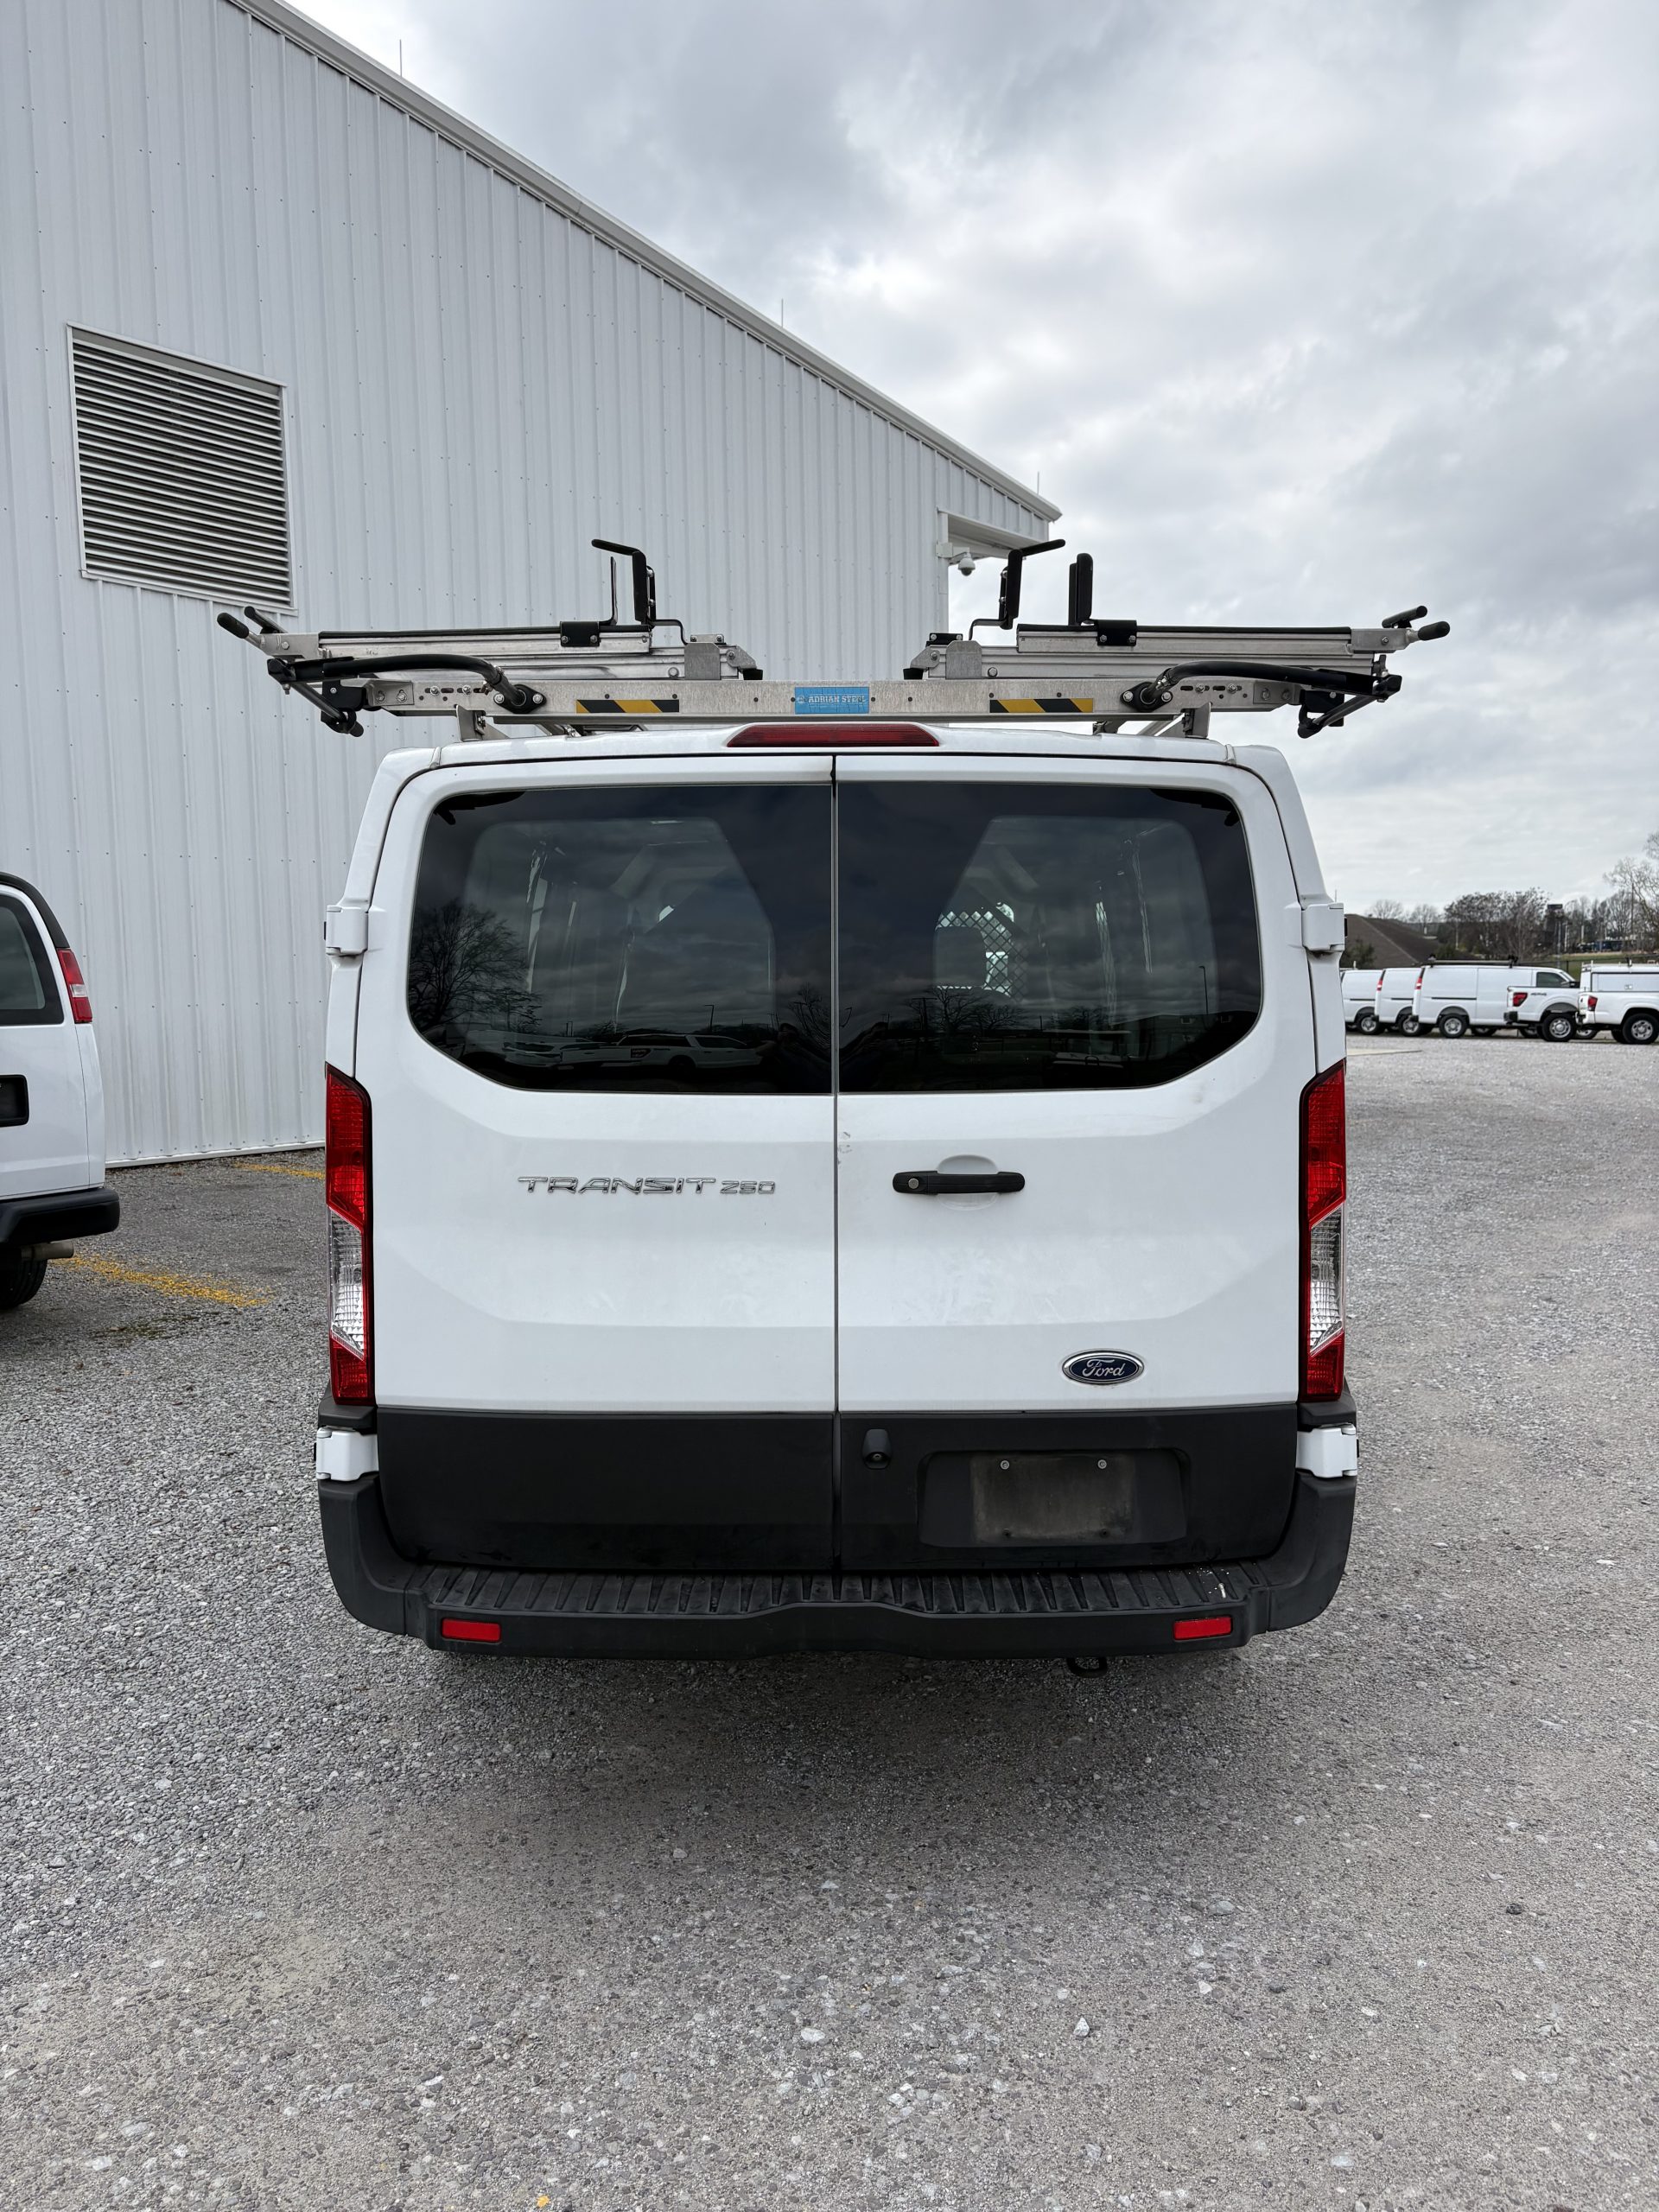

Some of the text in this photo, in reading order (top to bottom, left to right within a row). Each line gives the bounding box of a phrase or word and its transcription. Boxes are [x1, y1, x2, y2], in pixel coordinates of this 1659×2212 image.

[808, 695, 867, 703] ADRIAN STEEL
[518, 1176, 776, 1195] TRANSIT 250
[1082, 1358, 1125, 1377] Ford
